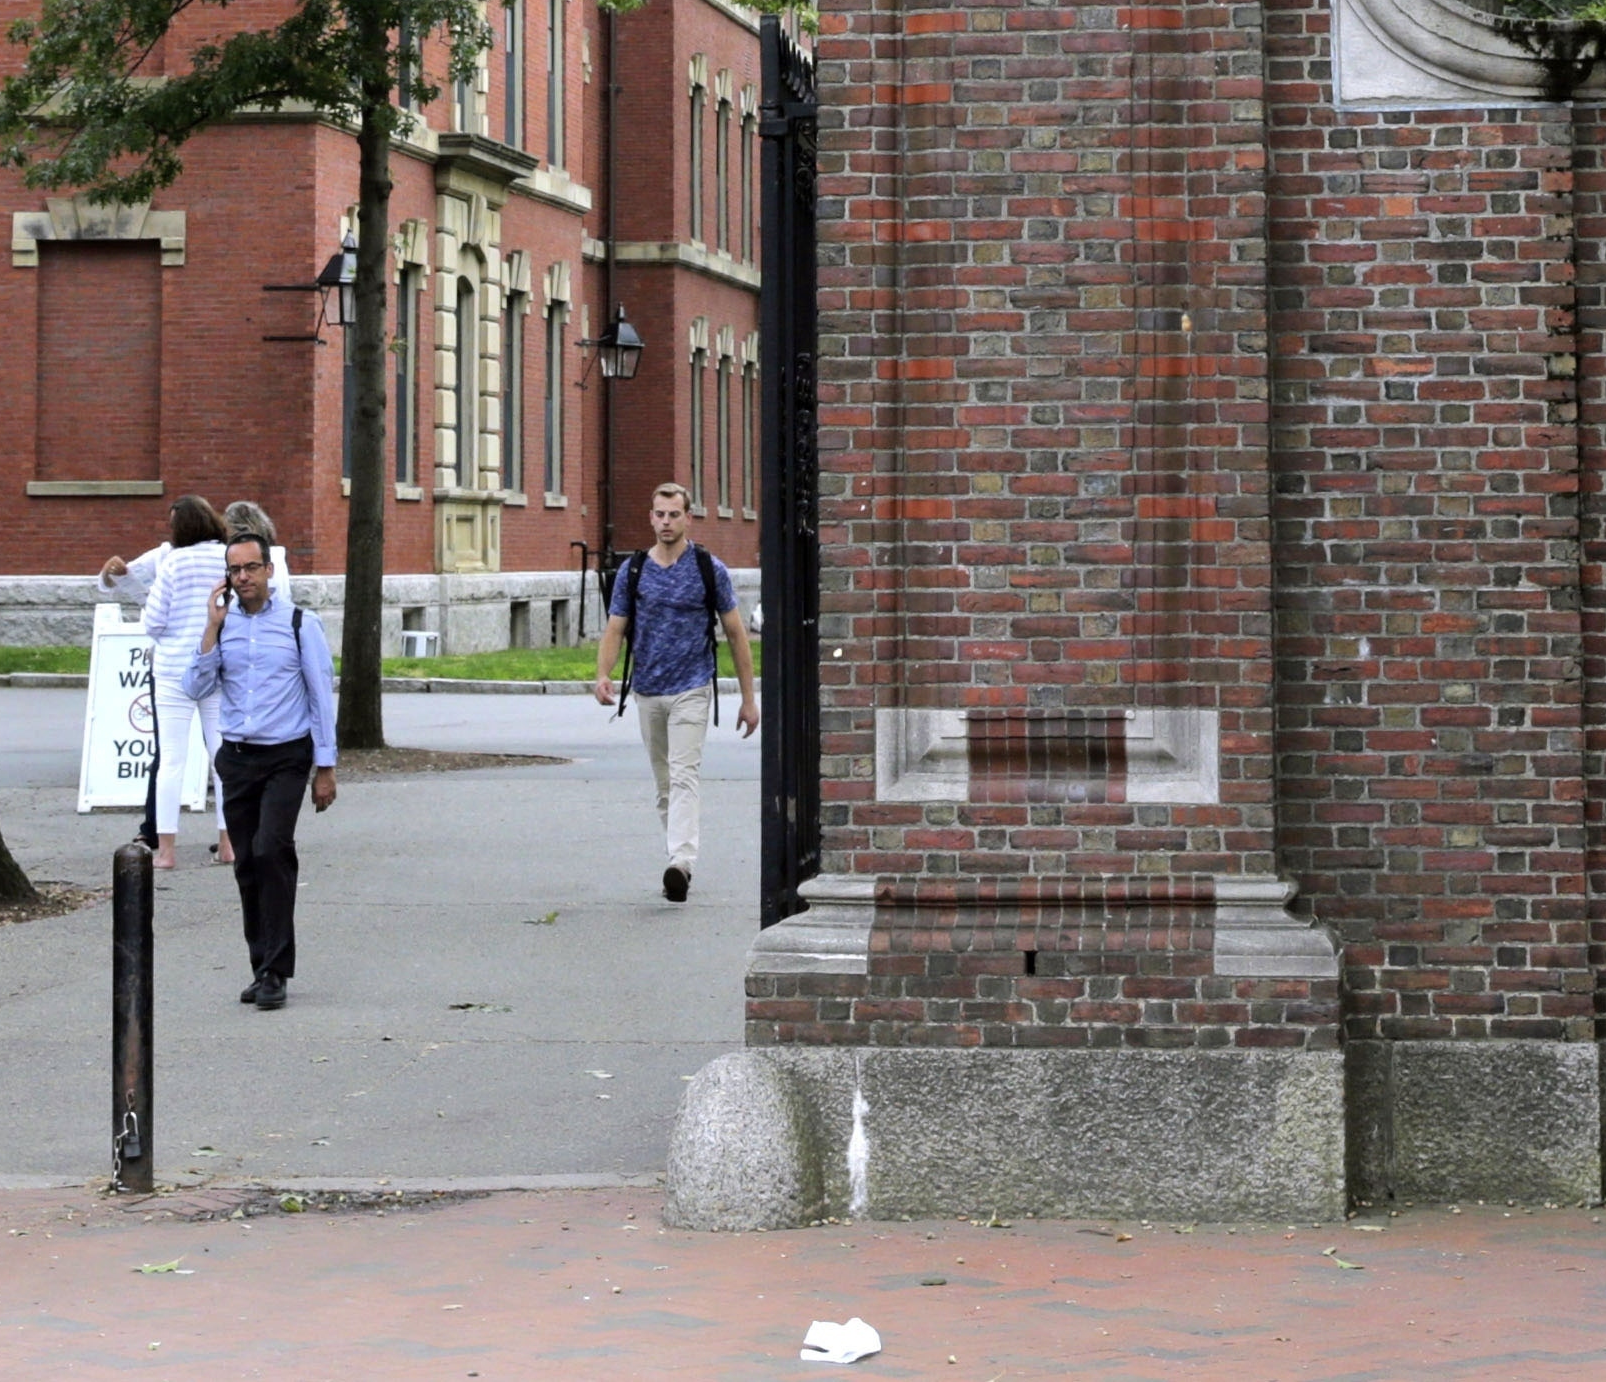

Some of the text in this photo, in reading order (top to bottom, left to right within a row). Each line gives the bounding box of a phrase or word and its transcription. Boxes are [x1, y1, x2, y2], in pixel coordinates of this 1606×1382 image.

[119, 671, 151, 688] WA
[113, 739, 155, 757] YOU
[118, 761, 151, 779] BIK
